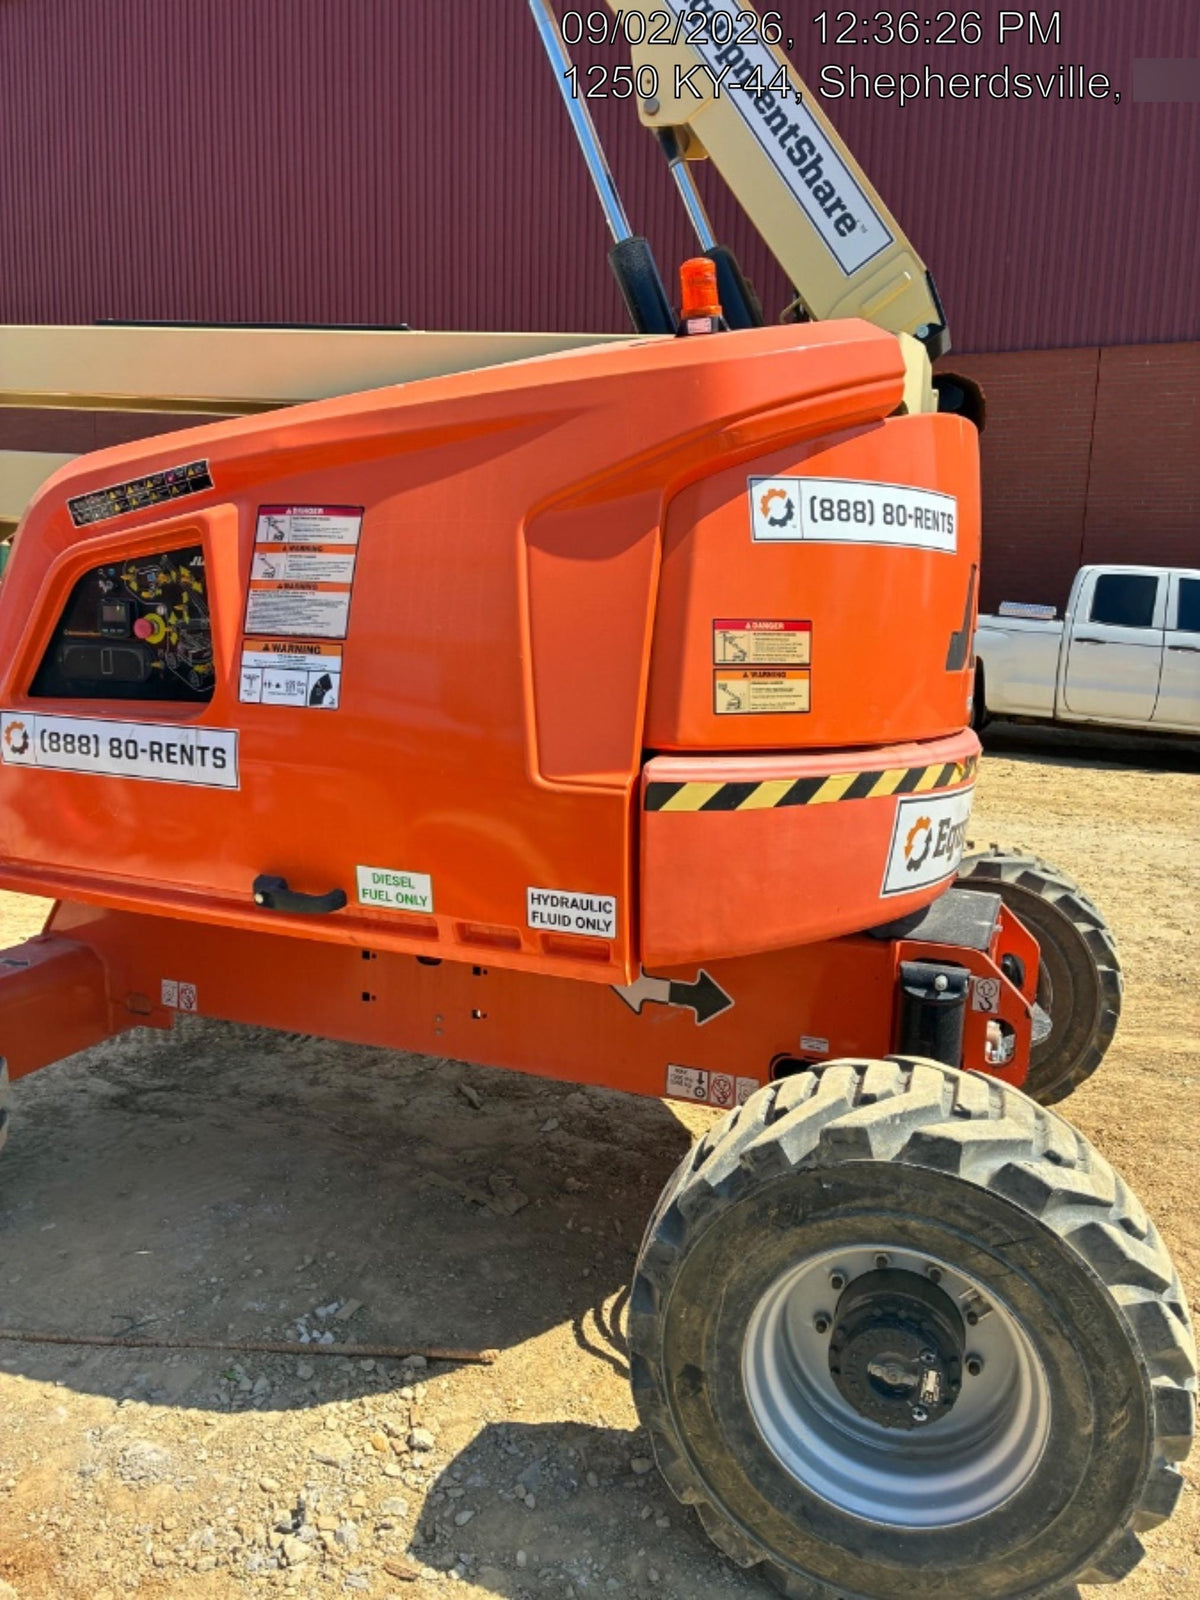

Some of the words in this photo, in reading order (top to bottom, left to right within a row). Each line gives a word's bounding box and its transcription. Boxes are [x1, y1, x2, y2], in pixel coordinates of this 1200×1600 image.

[684, 0, 857, 237] quipmentShare
[810, 495, 875, 526] (888)
[882, 502, 954, 535] 80-RENTS
[271, 643, 321, 655] WARNING
[40, 728, 100, 758] (888)
[109, 737, 227, 769] 80-RENTS
[371, 872, 415, 889] DIESEL
[362, 888, 392, 902] FUEL
[395, 893, 428, 907] ONLY
[530, 892, 613, 915] HYDRAULIC
[531, 911, 571, 927] FLUID
[575, 916, 612, 933] ONLY
